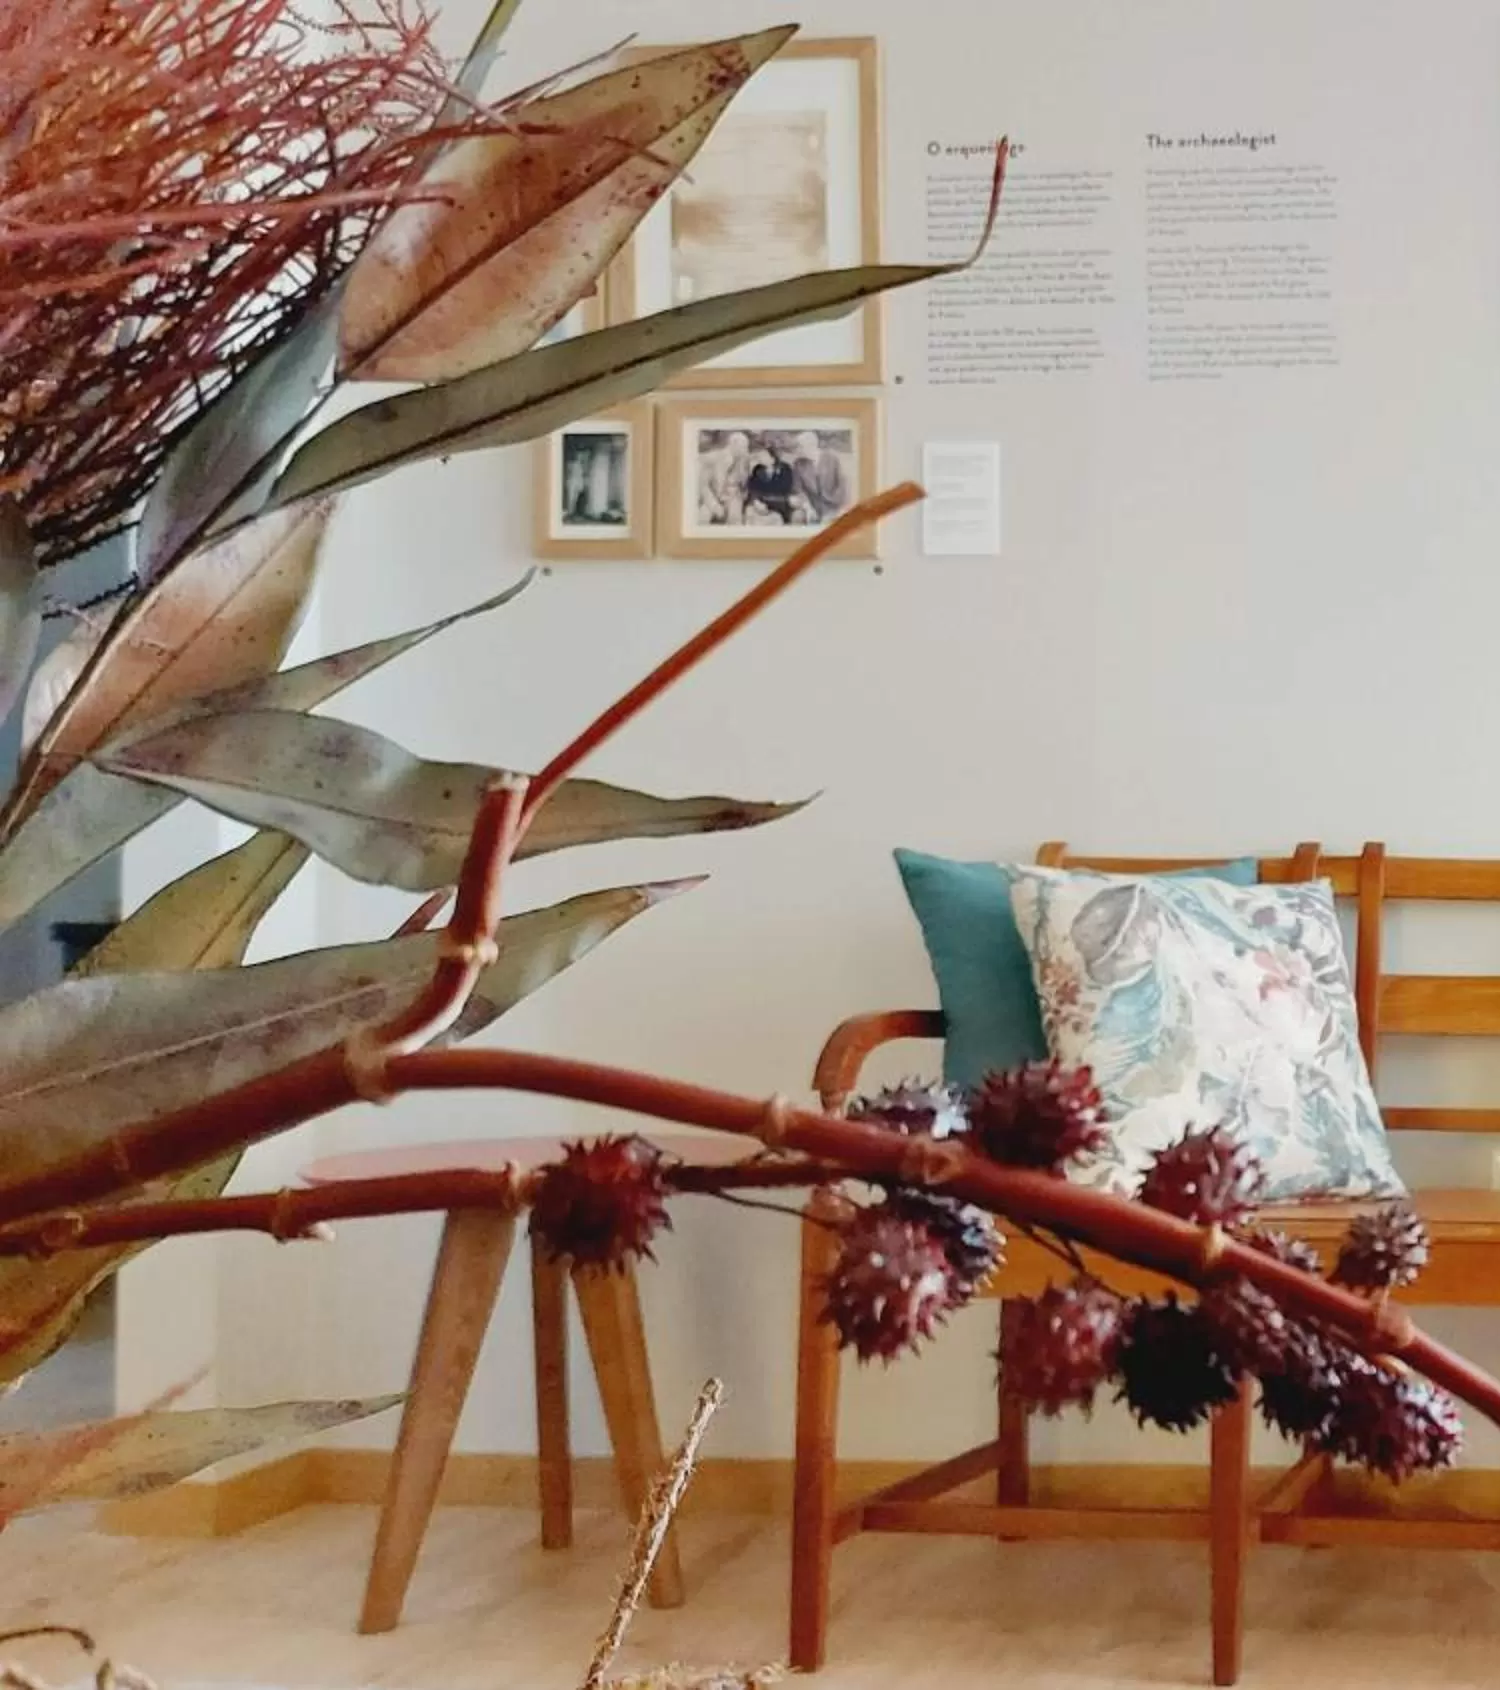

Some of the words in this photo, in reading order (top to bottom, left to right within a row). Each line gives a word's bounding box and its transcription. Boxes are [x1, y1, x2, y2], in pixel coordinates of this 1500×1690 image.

[927, 141, 941, 156] O
[1146, 133, 1173, 148] The
[1178, 131, 1275, 152] archaeologist
